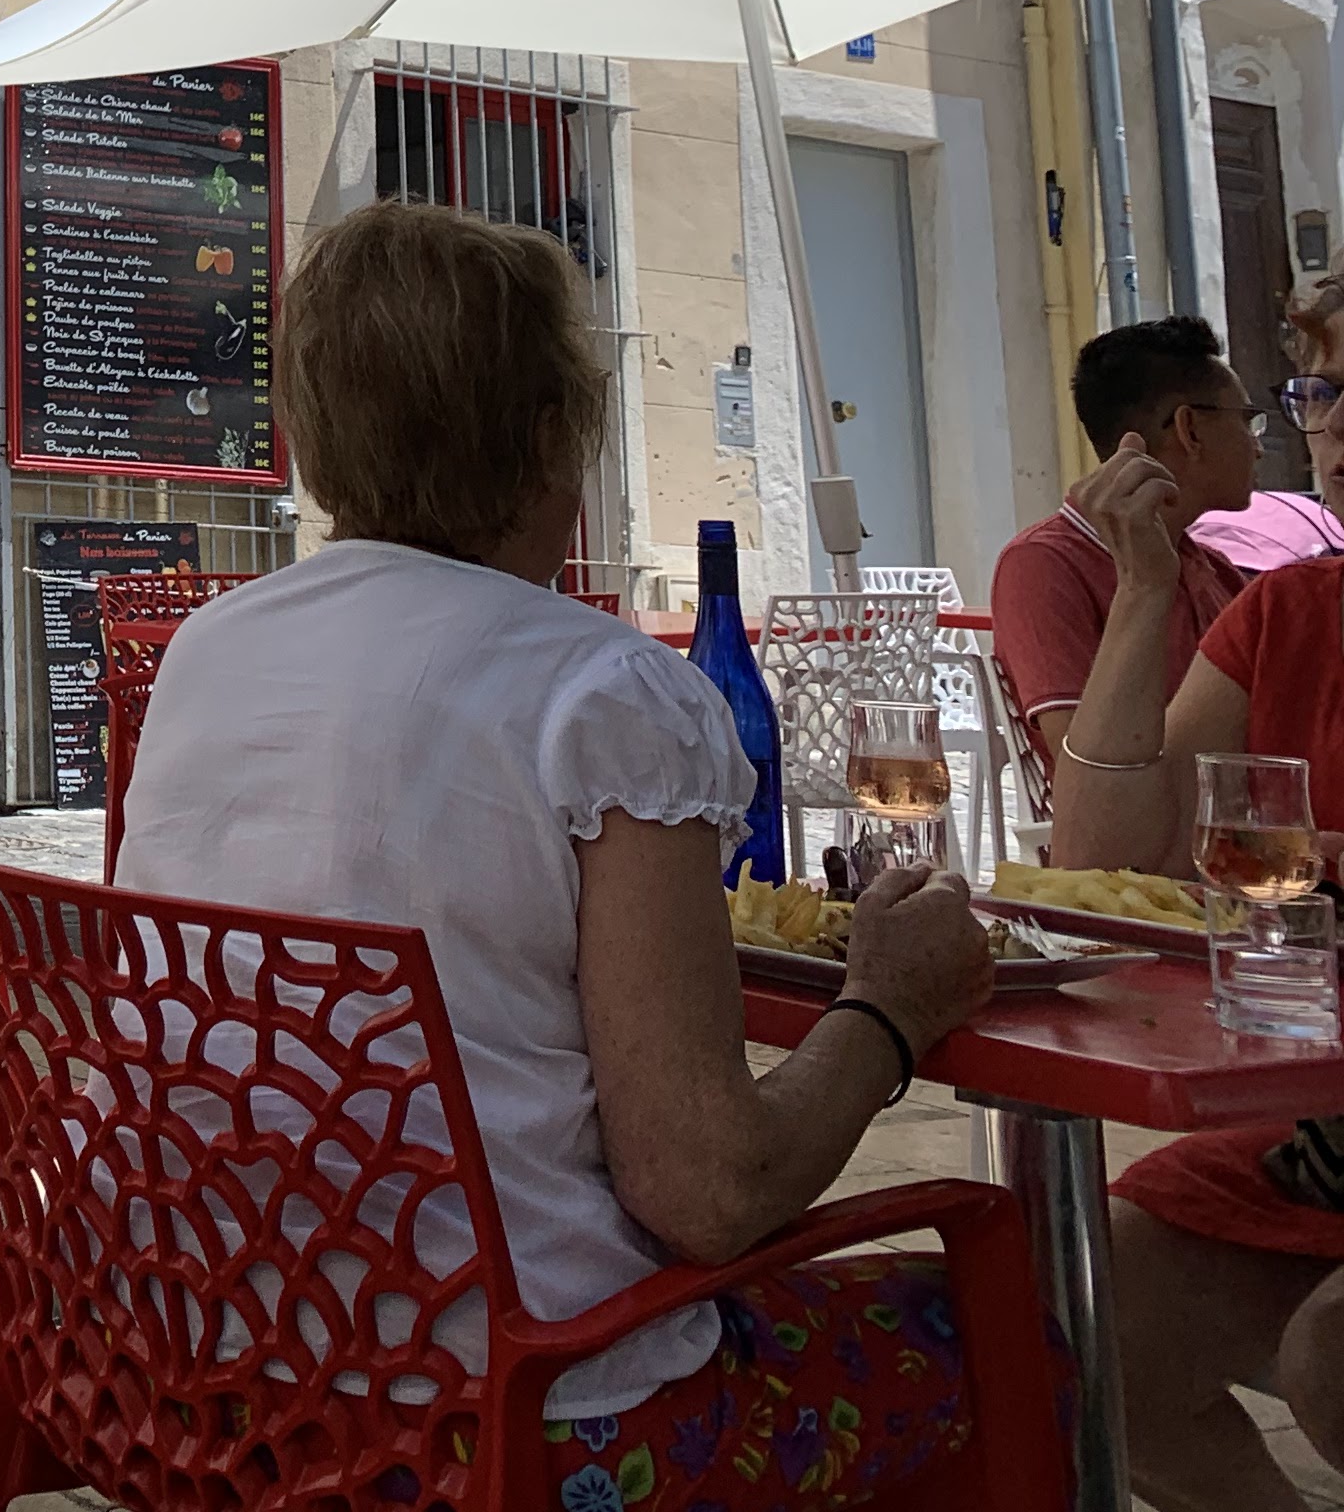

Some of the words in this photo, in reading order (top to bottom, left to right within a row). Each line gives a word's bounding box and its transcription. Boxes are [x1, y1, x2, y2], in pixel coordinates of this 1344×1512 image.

[152, 76, 167, 86] du
[169, 74, 214, 91] Panier
[42, 88, 82, 103] Salade
[84, 94, 98, 105] de
[140, 100, 172, 112] chaud
[42, 104, 83, 118] Salade
[85, 109, 99, 120] de
[116, 110, 143, 124] Mer
[42, 129, 84, 143] Salade
[42, 163, 83, 178] Salade
[150, 173, 196, 188] brochette
[42, 199, 84, 214] Salade
[87, 201, 123, 220] Veggie
[42, 223, 90, 239] Sardines
[122, 254, 152, 268] pistou
[132, 271, 146, 282] de
[82, 284, 97, 295] de
[79, 299, 93, 309] de
[94, 302, 134, 316] poissons
[43, 311, 78, 325] Daube
[81, 315, 96, 326] de
[97, 317, 135, 332] poulpes
[72, 329, 87, 341] de
[43, 342, 99, 358] Carpaccio
[101, 345, 115, 356] de
[43, 402, 86, 417] Piccata
[88, 407, 102, 419] de
[43, 422, 79, 435] Cuisse
[81, 425, 96, 436] de
[98, 428, 130, 445] poulet
[43, 439, 84, 457] Burger
[87, 443, 101, 454] de
[136, 530, 172, 541] Panier
